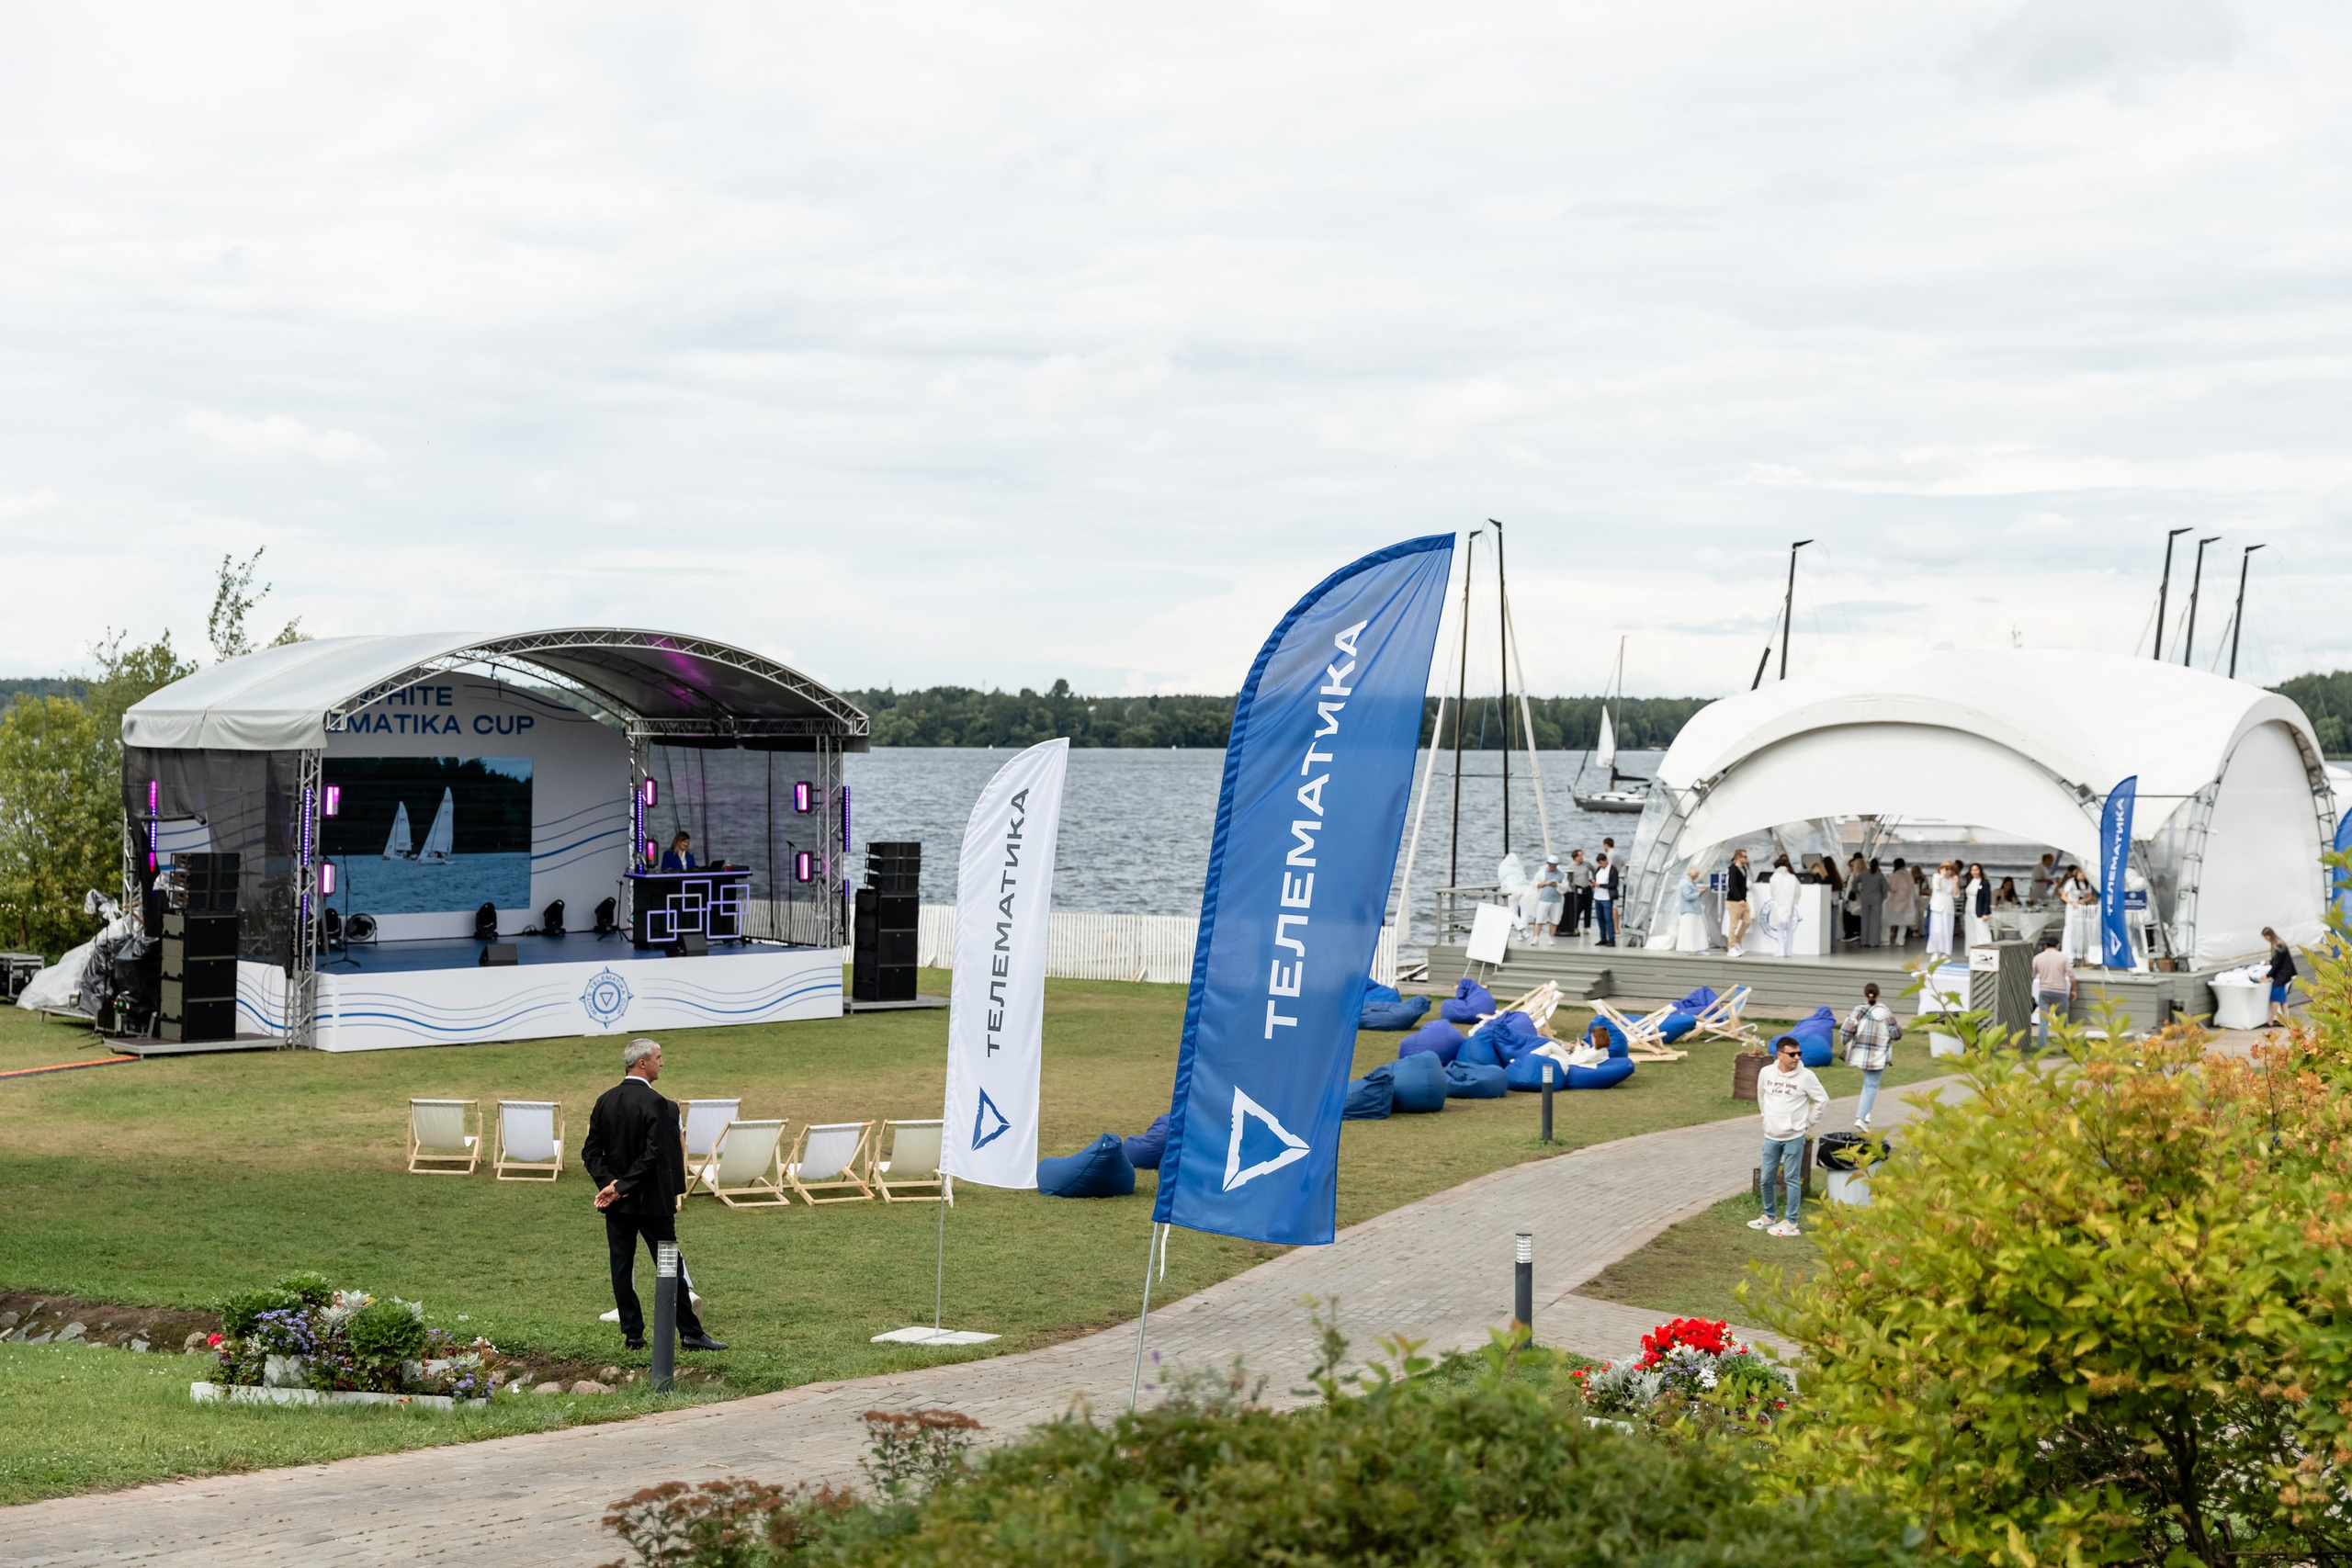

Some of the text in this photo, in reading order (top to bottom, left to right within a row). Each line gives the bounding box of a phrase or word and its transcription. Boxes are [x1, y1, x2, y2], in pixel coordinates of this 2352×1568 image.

[472, 715, 535, 735] CUP
[988, 788, 1029, 1057] ТЕЛЕМАТИКА
[1264, 619, 1368, 1040] ТЕЛЕМАТИКА
[2107, 797, 2125, 917] ТЕЛЕМАТИКА
